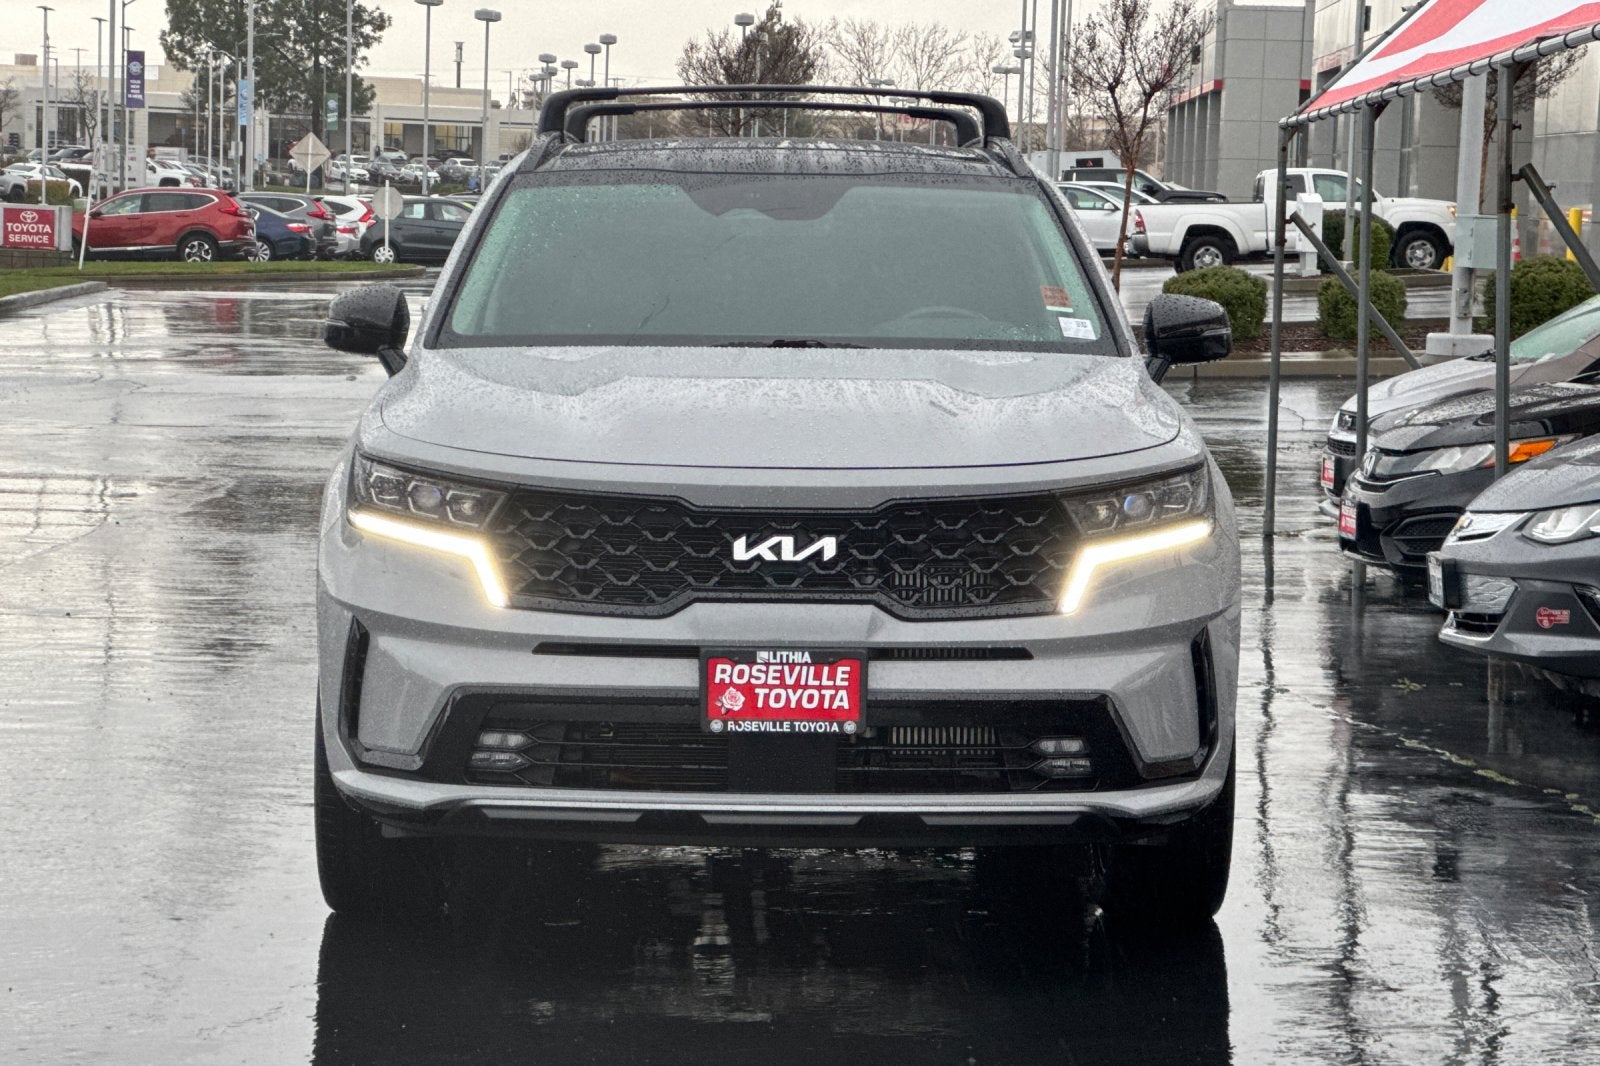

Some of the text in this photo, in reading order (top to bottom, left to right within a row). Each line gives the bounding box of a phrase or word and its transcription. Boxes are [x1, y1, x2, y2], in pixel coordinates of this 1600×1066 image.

[6, 222, 52, 233] TOYOTA
[8, 233, 49, 244] SERVICE
[733, 535, 837, 562] KIA
[769, 651, 812, 664] LITHIA
[714, 664, 851, 686] ROSEVILLE
[754, 688, 850, 710] TOYOTA
[727, 721, 840, 733] ROSEVILLE TOYOTA
